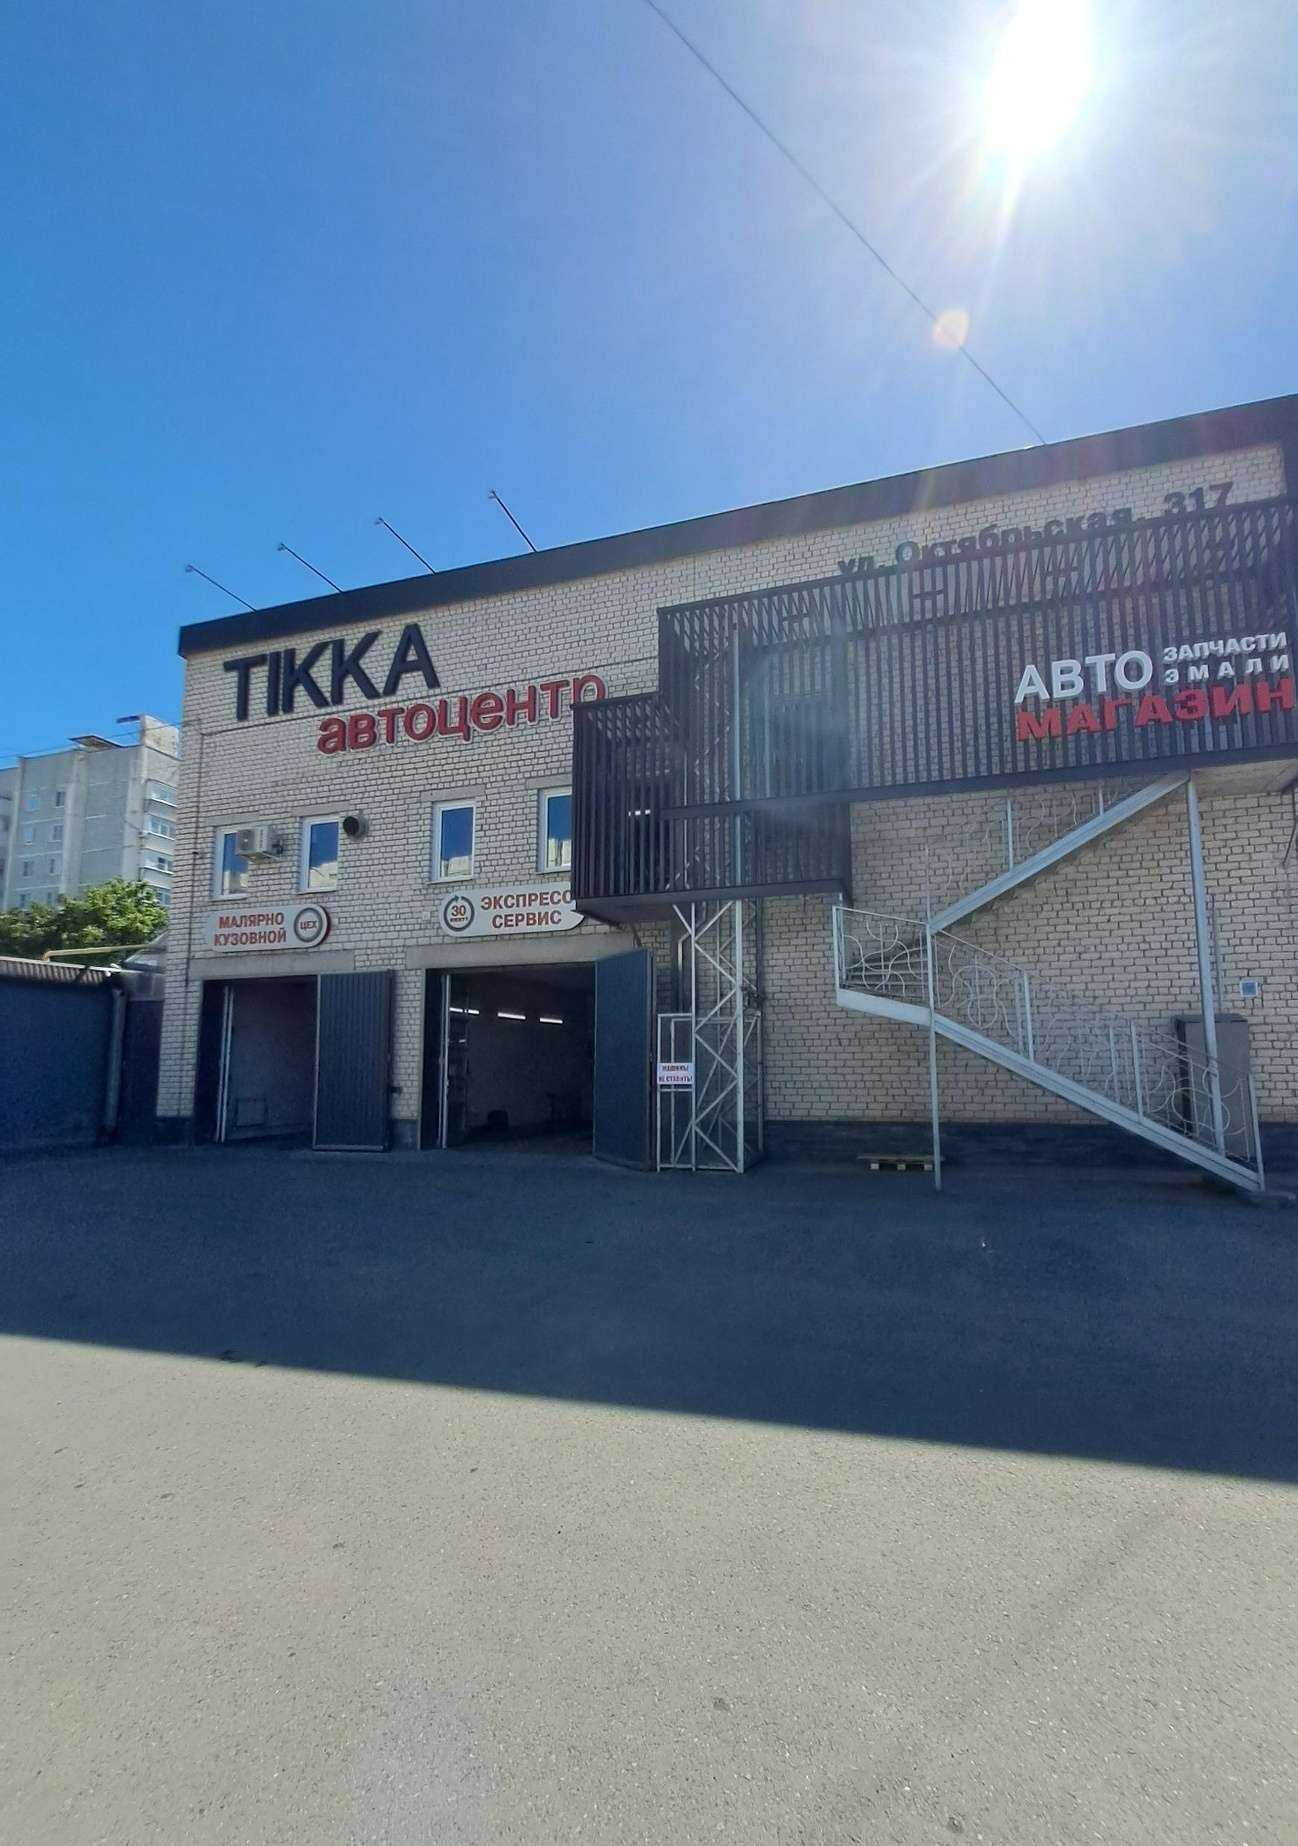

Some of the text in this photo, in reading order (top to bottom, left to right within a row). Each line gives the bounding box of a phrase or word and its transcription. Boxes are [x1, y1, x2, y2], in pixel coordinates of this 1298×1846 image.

[1163, 481, 1234, 516] 317
[1162, 631, 1288, 663] ЗАПЧАСТИ
[1014, 650, 1154, 705] АВТО
[316, 672, 608, 756] автоцентр
[1016, 676, 1296, 743] МАГАЗИН
[480, 890, 572, 910] ЭКСПРЕСС
[219, 912, 285, 929] МАЛЯРНО
[451, 904, 467, 917] 30
[492, 909, 562, 929] СЕРВИС
[300, 920, 318, 931] ЦЕХ
[214, 928, 287, 946] КУЗОВНОЙ
